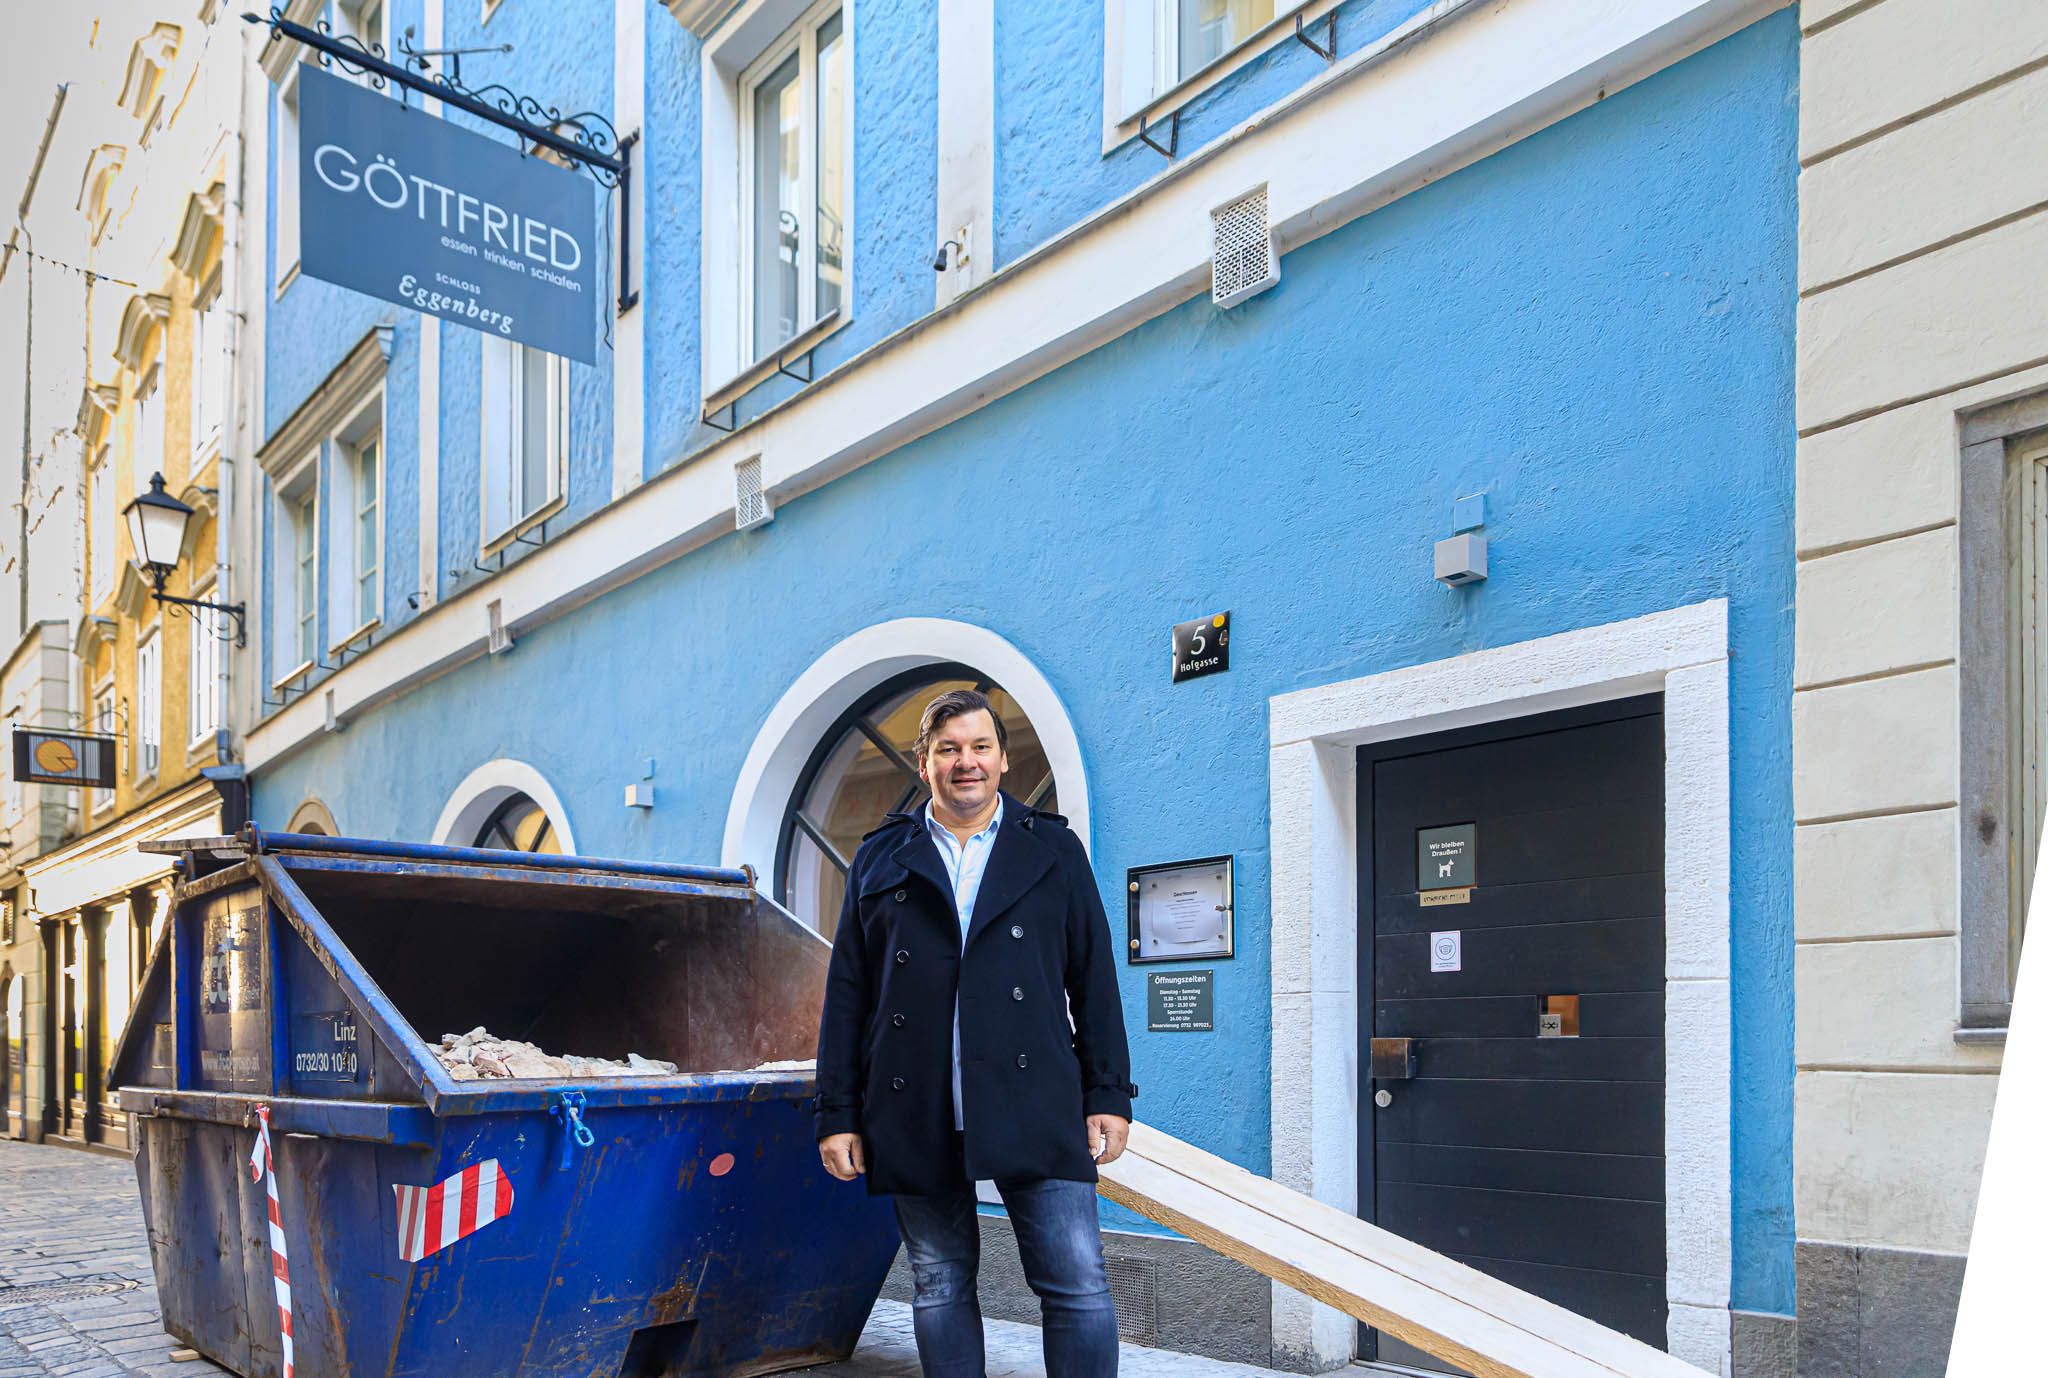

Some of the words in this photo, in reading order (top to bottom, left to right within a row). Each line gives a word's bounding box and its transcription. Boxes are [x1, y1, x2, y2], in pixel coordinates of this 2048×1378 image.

[314, 145, 582, 271] GÖTTFRIED
[440, 235, 478, 257] essen
[484, 248, 525, 273] trinken
[530, 267, 582, 292] schlafen
[435, 272, 481, 295] SCHLOSS
[398, 274, 514, 334] Eggenberg
[1190, 624, 1206, 655] 5
[1180, 656, 1219, 672] Hofgasse
[1441, 841, 1465, 849] bleiben
[1154, 975, 1207, 985] Öffnungszeiten
[334, 1021, 357, 1041] Linz
[296, 1052, 329, 1072] 0732/30
